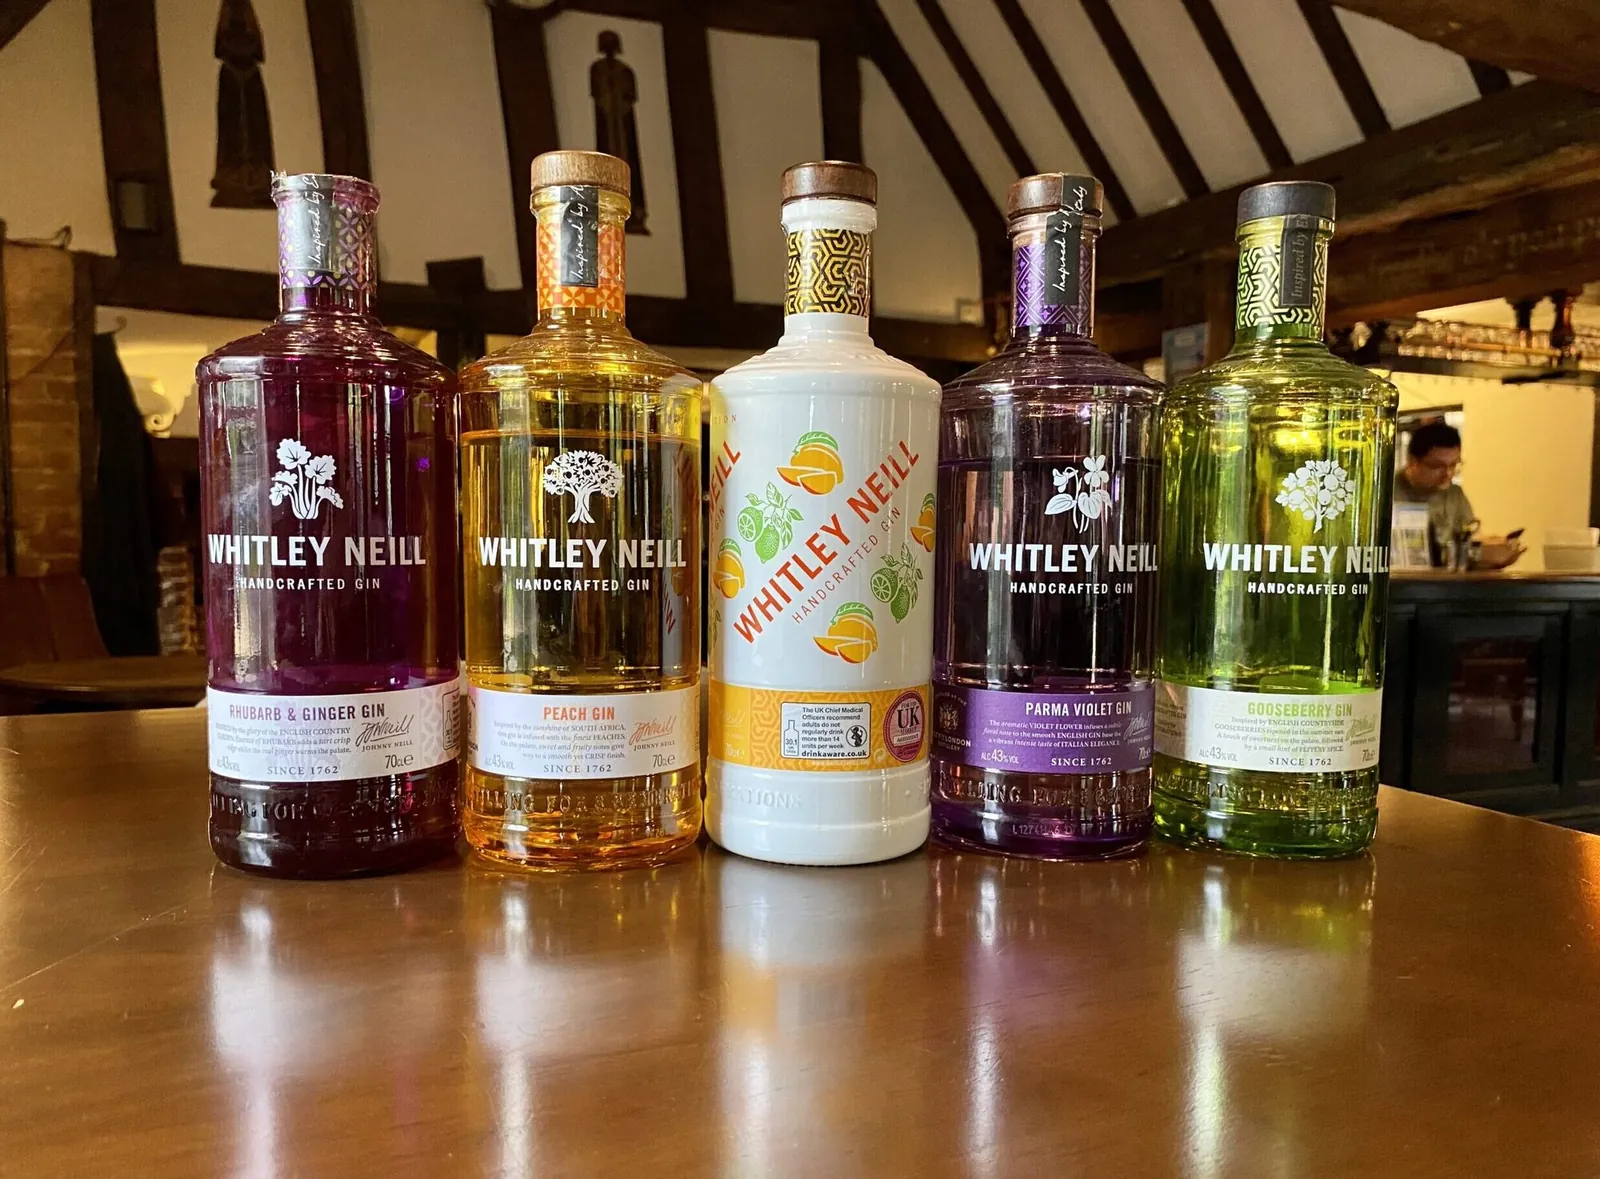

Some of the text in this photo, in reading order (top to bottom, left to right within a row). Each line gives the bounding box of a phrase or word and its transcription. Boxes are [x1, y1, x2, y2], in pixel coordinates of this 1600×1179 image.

[570, 202, 588, 217] by
[1055, 219, 1073, 233] by
[1290, 233, 1309, 297] Inspired by
[733, 440, 919, 644] WHITLEY NEILL
[208, 534, 426, 566] WHITLEY NEILL
[479, 536, 687, 568] WHITLEY NEILL
[969, 543, 1158, 573] WHITLEY NEILL
[1203, 543, 1388, 574] WHITLEY NEILL
[792, 507, 901, 624] HANDCRAFTED GIN
[240, 577, 380, 590] HANDCRAFTED GIN
[516, 578, 650, 591] HANDCRAFTED GIN
[1010, 581, 1133, 594] HANDCRAFTED GIN
[1248, 582, 1368, 595] HANDCRAFTED GIN
[230, 703, 385, 721] RHUBARB & GINGER GIN
[543, 706, 615, 720] PEACH GIN
[1026, 701, 1132, 716] PARMA VIOLET GIN
[1248, 702, 1352, 717] GOOSEBERRY GIN
[897, 706, 920, 729] UK
[1259, 718, 1267, 727] by
[280, 728, 311, 736] ENGLISH
[313, 727, 351, 736] COUNTRY
[523, 722, 532, 731] the
[599, 723, 627, 731] AFRICA,
[334, 737, 351, 748] crisp
[362, 743, 392, 752] JOHNNY
[557, 742, 571, 751] and
[611, 743, 625, 751] give
[634, 743, 659, 751] JOHNNY
[318, 746, 329, 754] the
[585, 752, 606, 760] CRISP
[1051, 757, 1112, 766] SINCE 1762
[1269, 757, 1332, 766] SINCE 1762
[267, 765, 338, 775] SINCE 1762
[543, 764, 613, 774] SINCE 1762
